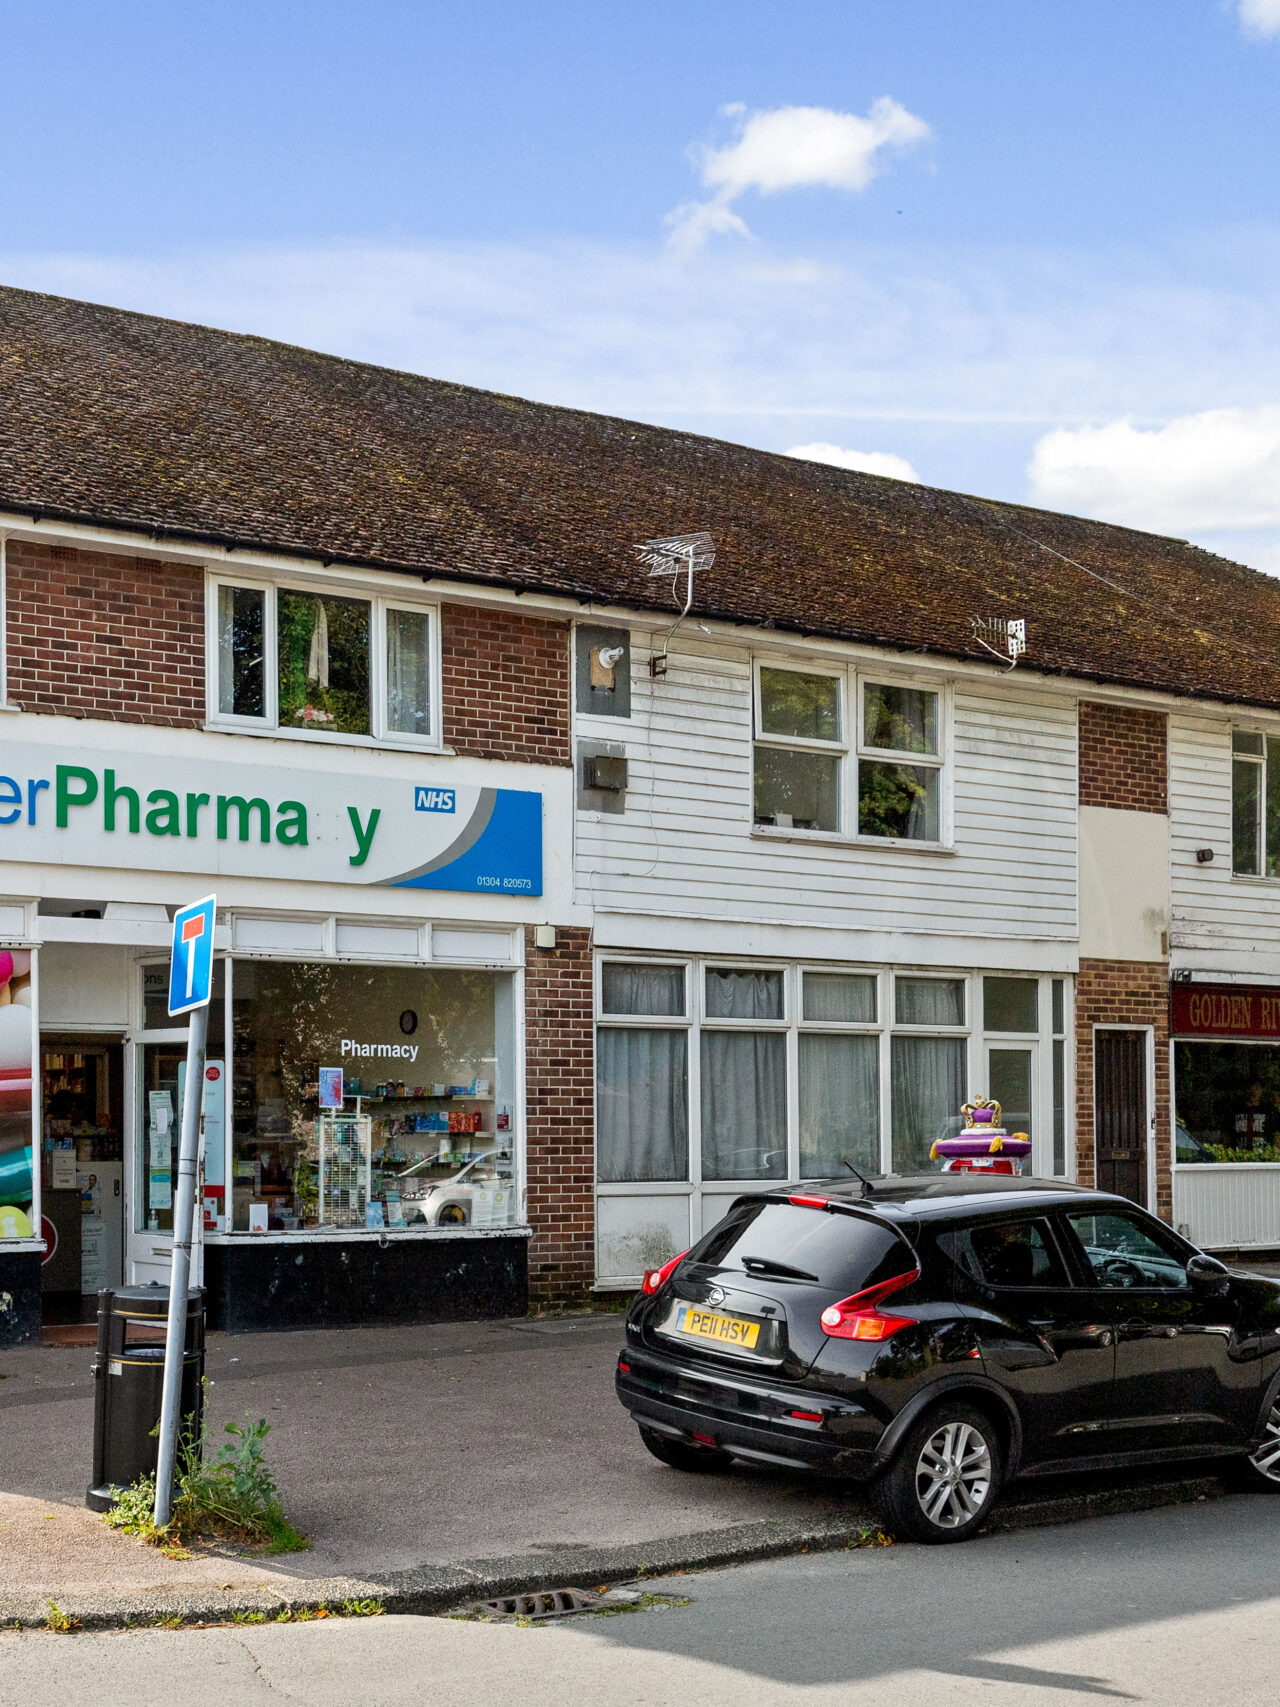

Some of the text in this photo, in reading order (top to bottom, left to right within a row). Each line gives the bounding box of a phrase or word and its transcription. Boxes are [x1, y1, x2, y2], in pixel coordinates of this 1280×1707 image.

[417, 790, 454, 810] NHS
[477, 876, 532, 889] 01304 820573
[1189, 993, 1252, 1029] GOLDEN
[341, 1039, 419, 1062] Pharmacy
[719, 1318, 751, 1342] HSV
